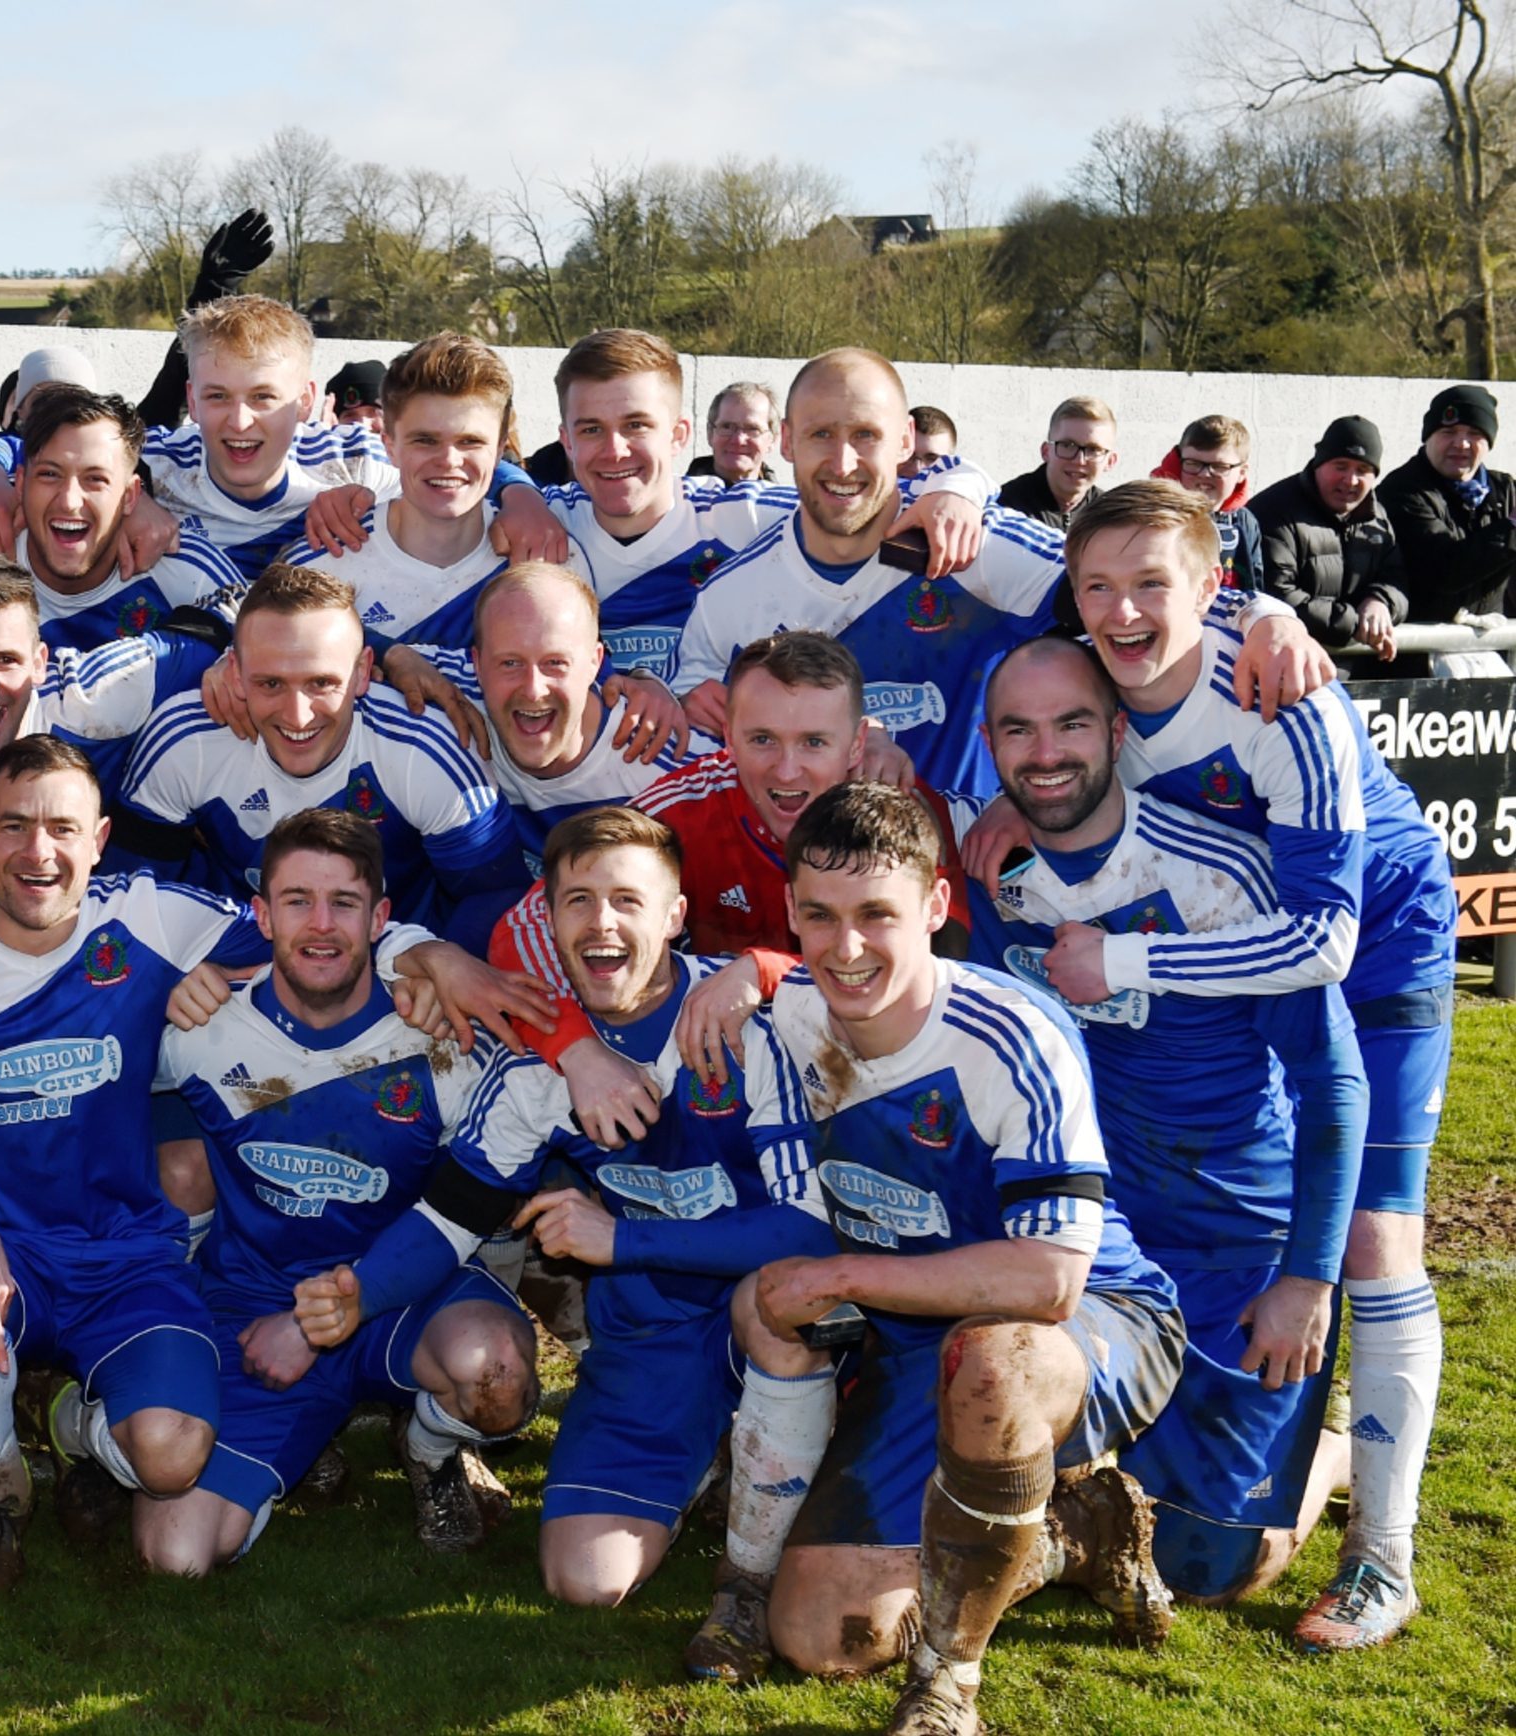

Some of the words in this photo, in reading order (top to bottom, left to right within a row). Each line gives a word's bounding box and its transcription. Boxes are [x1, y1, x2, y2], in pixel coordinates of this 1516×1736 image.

[1352, 698, 1516, 759] Takeaw
[40, 1068, 103, 1093] CITY
[220, 1077, 258, 1089] adidas
[251, 1148, 363, 1181] RAINBOW
[300, 1181, 364, 1199] CITY
